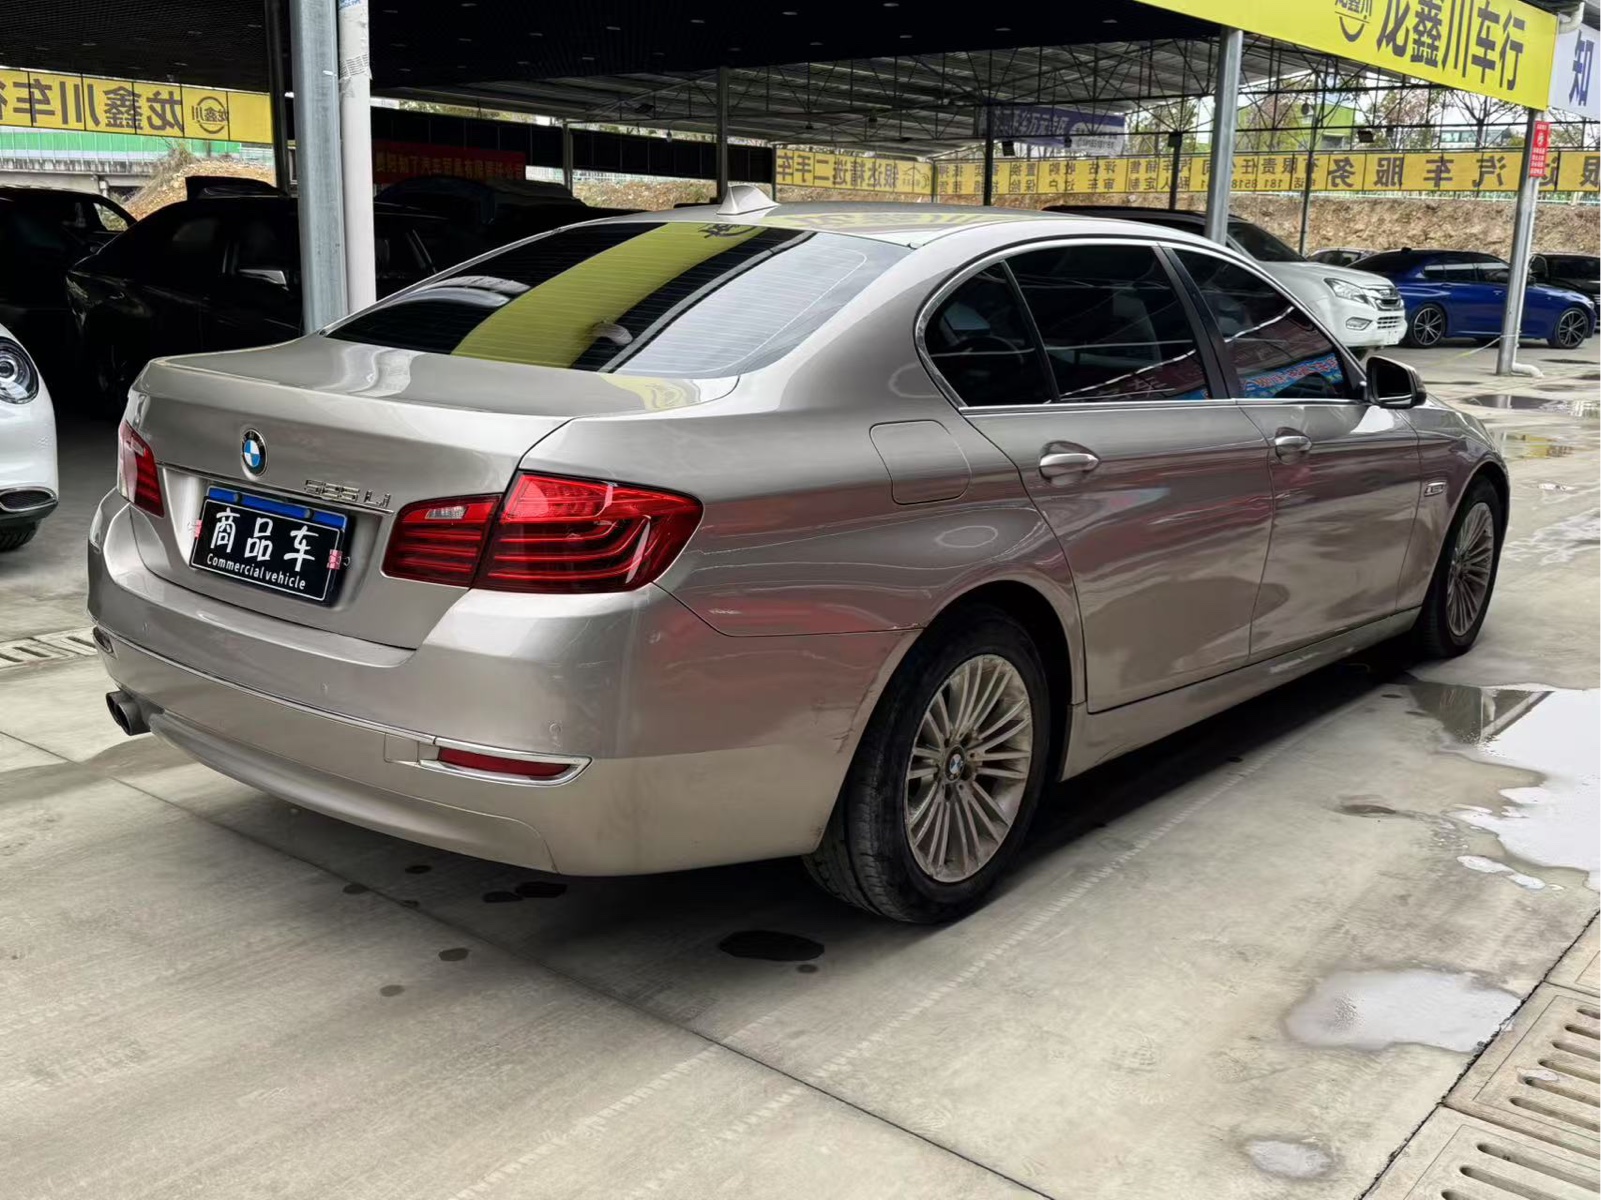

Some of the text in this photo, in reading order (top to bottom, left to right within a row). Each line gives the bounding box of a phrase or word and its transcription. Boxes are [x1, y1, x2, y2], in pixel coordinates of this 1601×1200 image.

[210, 507, 319, 572] 商品车
[206, 553, 306, 590] Commercial vehicle
